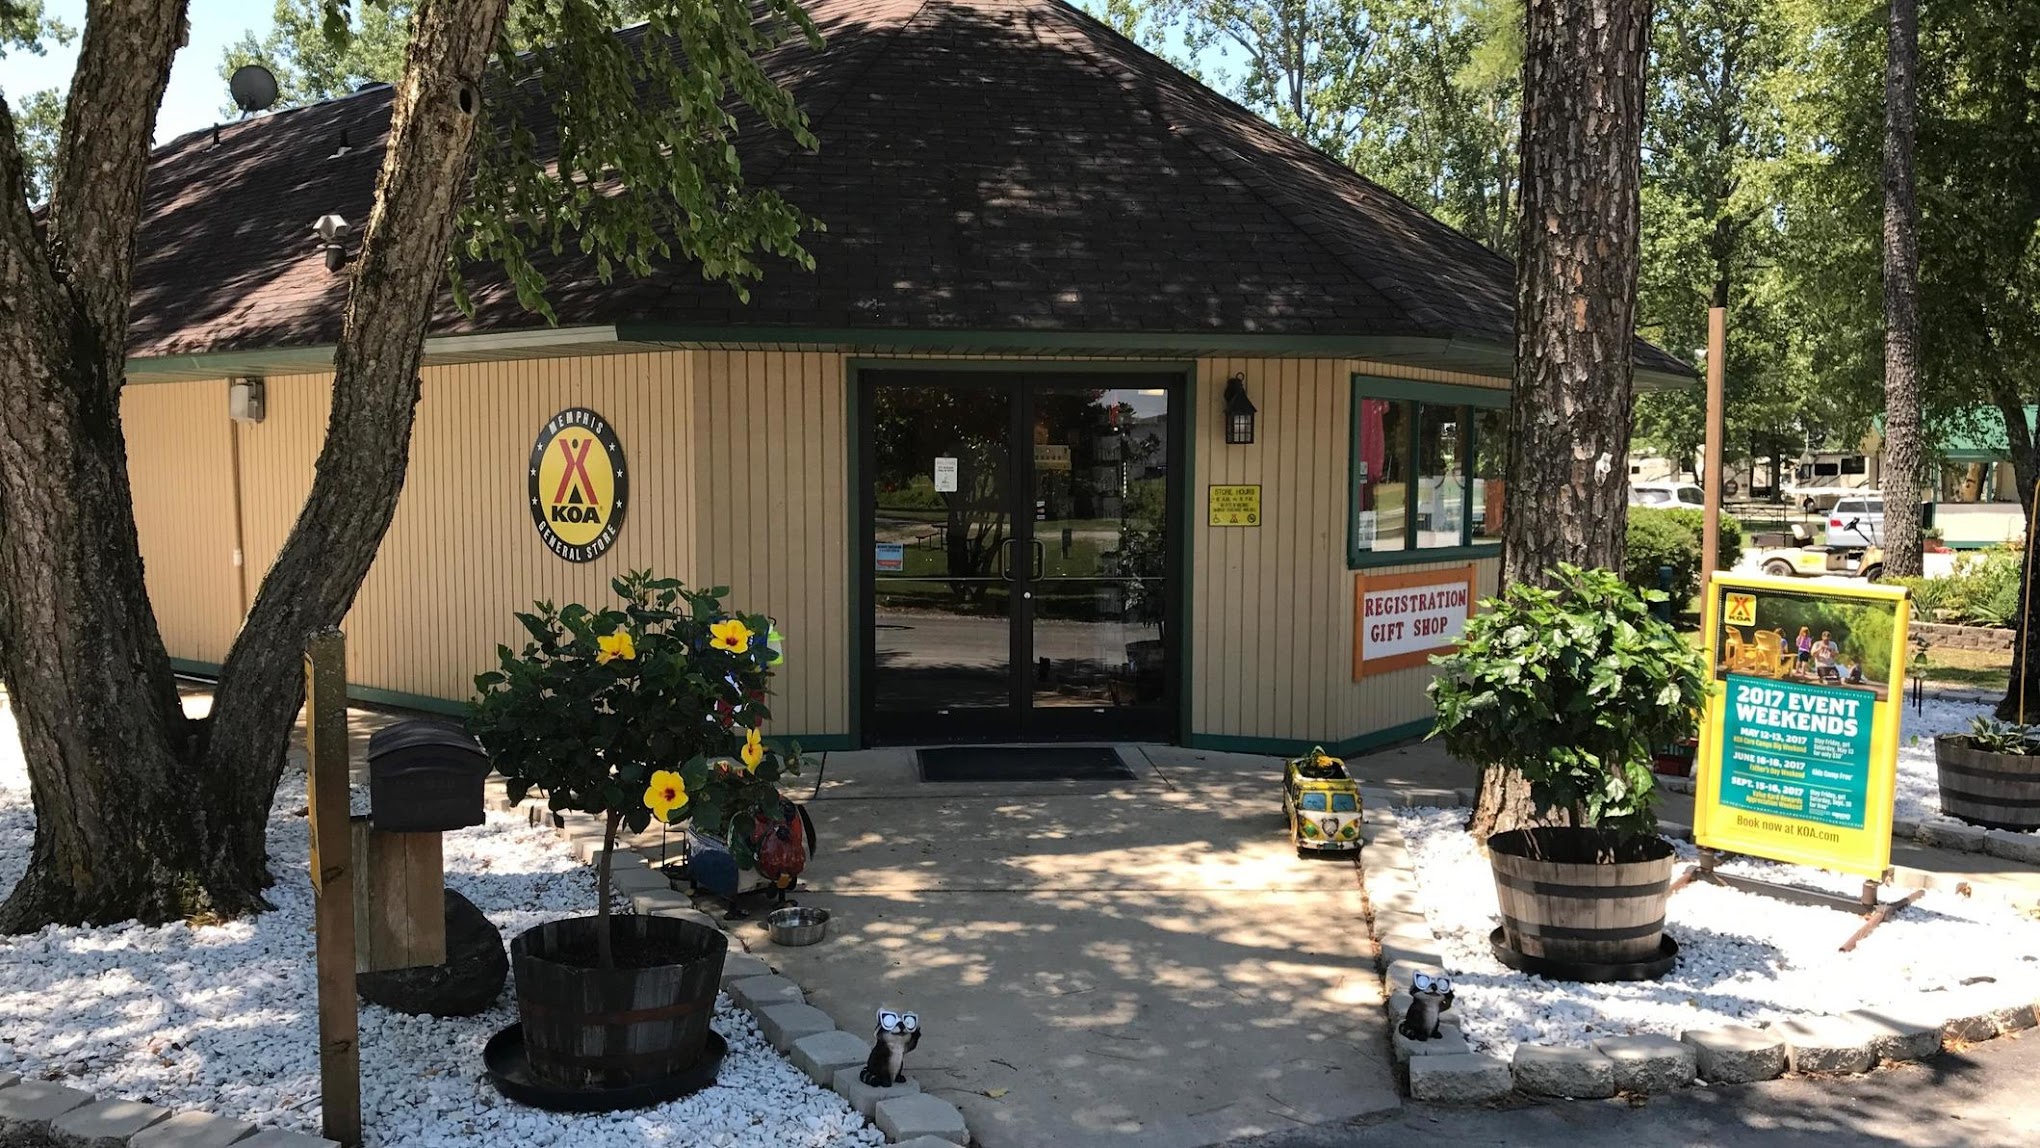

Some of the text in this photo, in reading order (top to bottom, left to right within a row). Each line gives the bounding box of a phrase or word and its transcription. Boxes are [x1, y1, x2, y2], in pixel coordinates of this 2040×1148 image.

[548, 410, 604, 435] MEMPHIS
[551, 505, 602, 524] KOA
[538, 520, 617, 561] GENERAL STORE
[1365, 588, 1467, 618] REGISTRATION
[1371, 616, 1448, 643] GIFT SHOP
[1728, 615, 1752, 623] KOA
[1737, 685, 1860, 718] 2017 EVENT
[1736, 702, 1858, 737] WEEKENDS
[1740, 727, 1760, 738] MAY
[1785, 734, 1808, 745] 2017
[1733, 751, 1756, 763] JUNE
[1783, 760, 1806, 770] 2017
[1731, 776, 1754, 788] SEPT.
[1782, 785, 1804, 796] 2017
[1737, 815, 1840, 843] Book now at KOA.com
